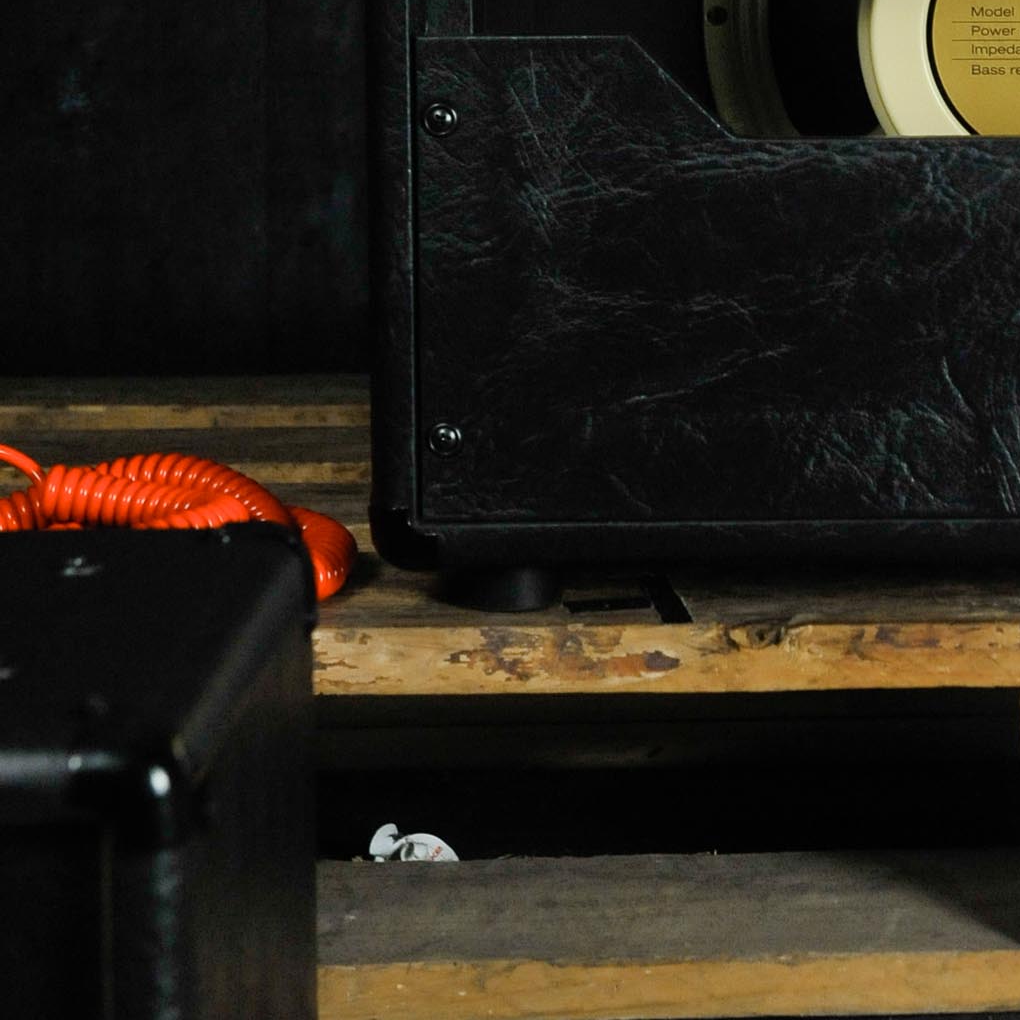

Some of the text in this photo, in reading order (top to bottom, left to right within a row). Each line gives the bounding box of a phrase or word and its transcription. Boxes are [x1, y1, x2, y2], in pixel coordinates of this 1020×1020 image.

[970, 6, 1015, 18] Model
[971, 25, 1016, 36] Power
[971, 64, 1006, 76] Bass
